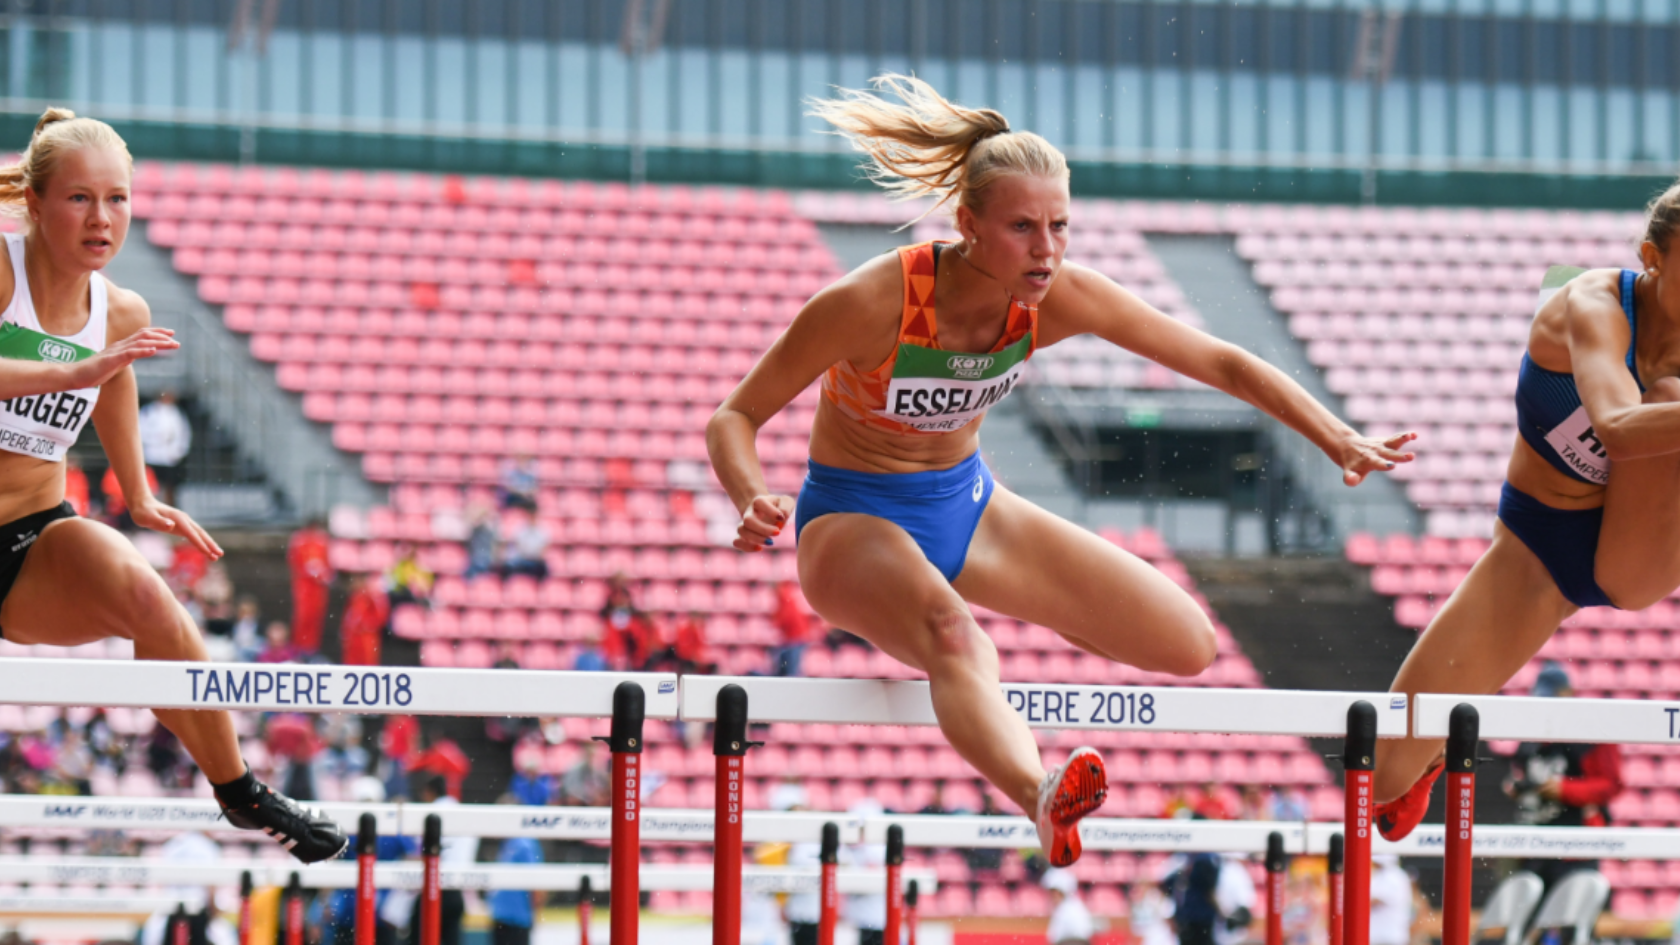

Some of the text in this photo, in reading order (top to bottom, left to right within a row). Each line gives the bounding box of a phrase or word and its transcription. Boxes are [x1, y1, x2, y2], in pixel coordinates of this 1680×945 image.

[42, 341, 73, 362] KOTI
[953, 357, 989, 370] KOTI
[0, 428, 32, 451] PERE
[186, 669, 413, 706] TAMPERE 2018
[1004, 689, 1156, 724] PERE 2018
[625, 768, 636, 821] MONDO
[728, 771, 739, 824] MONDO
[1357, 786, 1368, 838] MONDO
[1460, 788, 1471, 840] MONDO
